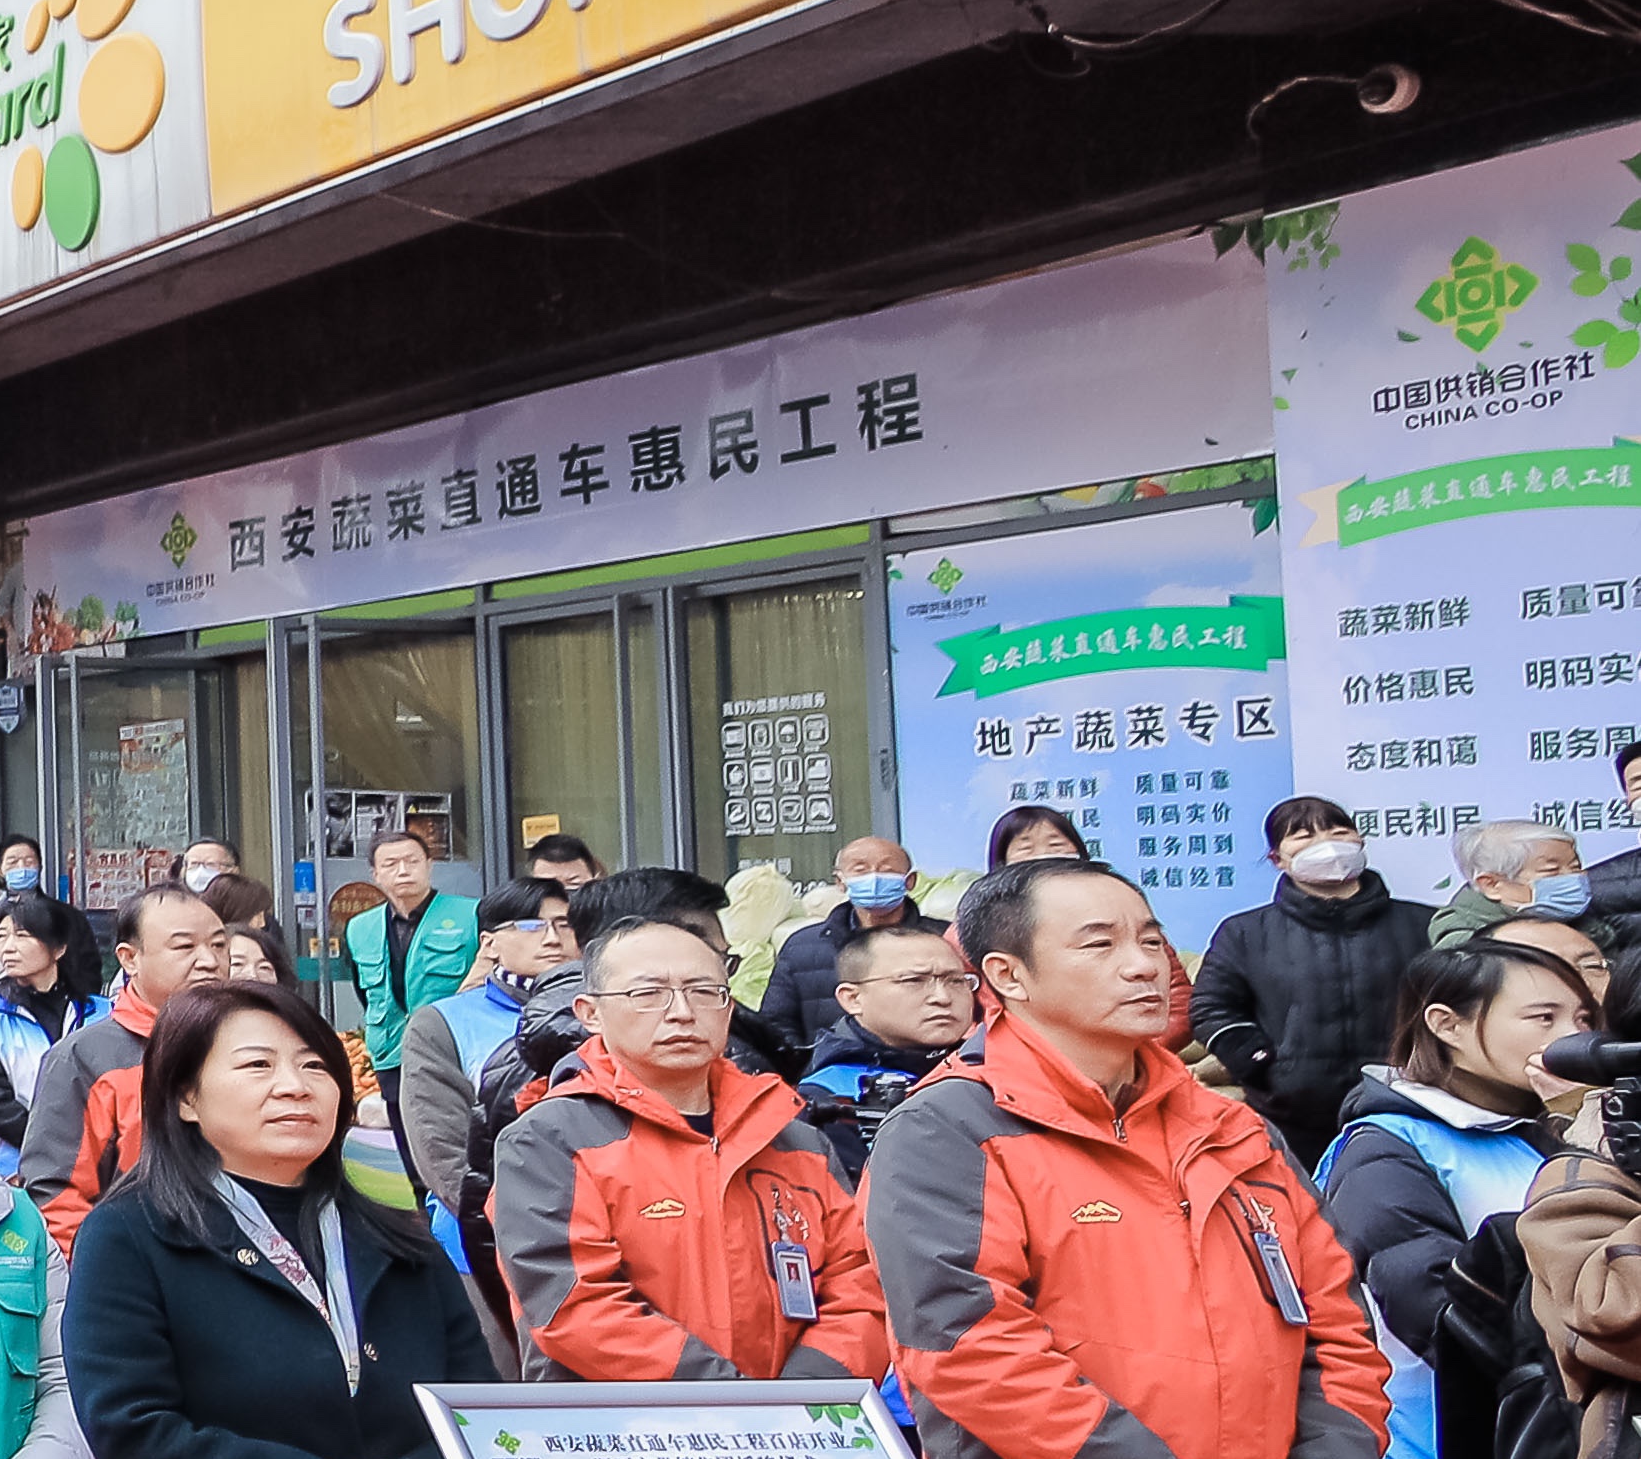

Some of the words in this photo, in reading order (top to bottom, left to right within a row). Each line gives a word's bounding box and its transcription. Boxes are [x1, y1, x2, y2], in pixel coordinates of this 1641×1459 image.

[1374, 350, 1596, 413] 中国供销合作社
[1405, 407, 1479, 430] CHINA
[1485, 390, 1564, 417] CO-OP
[229, 372, 923, 573] 西安蔬菜直通车惠民工程
[1343, 464, 1633, 526] 西安蔬菜直通车惠民工程
[1338, 595, 1471, 638] 蔬菜新鲜
[979, 622, 1248, 676] 西安蔬菜直通车惠民工程
[1342, 666, 1475, 706] 价格惠民
[1525, 652, 1641, 690] 明码实
[976, 695, 1276, 758] 地产蔬菜专区
[1346, 734, 1478, 772] 态度和蔼
[1529, 723, 1641, 762] 服务周
[1010, 776, 1101, 802] 蔬菜新鲜
[1134, 768, 1232, 796] 质量可靠
[1136, 801, 1232, 826] 明码实价
[1137, 832, 1234, 859] 服务周到
